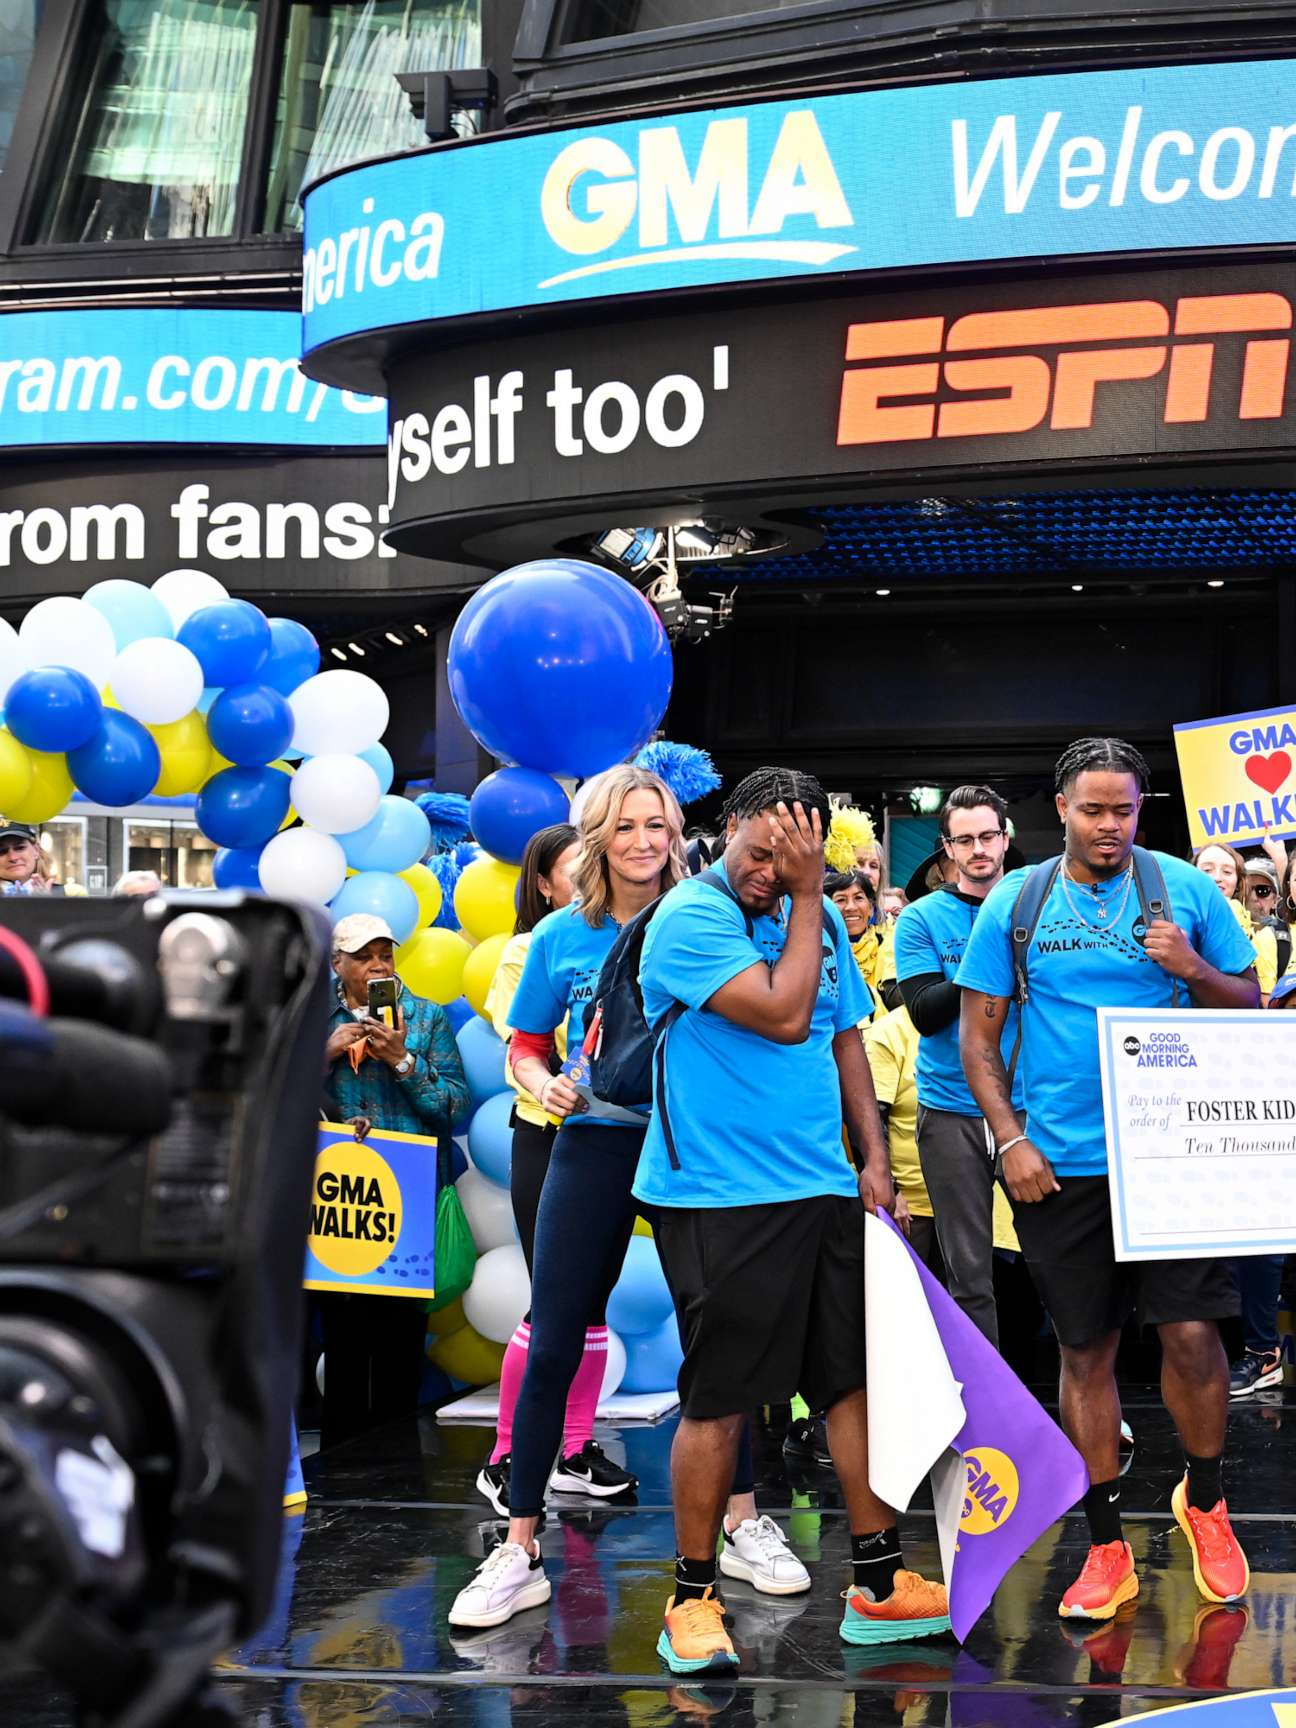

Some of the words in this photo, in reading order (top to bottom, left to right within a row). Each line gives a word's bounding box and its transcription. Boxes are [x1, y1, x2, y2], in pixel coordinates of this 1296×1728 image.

[540, 110, 854, 256] GMA
[836, 291, 1293, 447] ESPN
[546, 345, 729, 458] too'
[1038, 938, 1082, 953] WALK
[1084, 941, 1108, 949] WITH
[1149, 1033, 1181, 1043] GOOD
[1142, 1043, 1190, 1054] MORNING
[1136, 1054, 1198, 1068] AMERICA
[1127, 1094, 1149, 1111] Pay
[1152, 1095, 1163, 1106] to
[1165, 1092, 1182, 1106] the
[1186, 1100, 1258, 1122] FOSTER
[1129, 1113, 1157, 1128] order
[1159, 1113, 1172, 1131] of
[1184, 1137, 1213, 1154] Ten
[1219, 1135, 1296, 1154] Thousand
[317, 1172, 385, 1208] GMA
